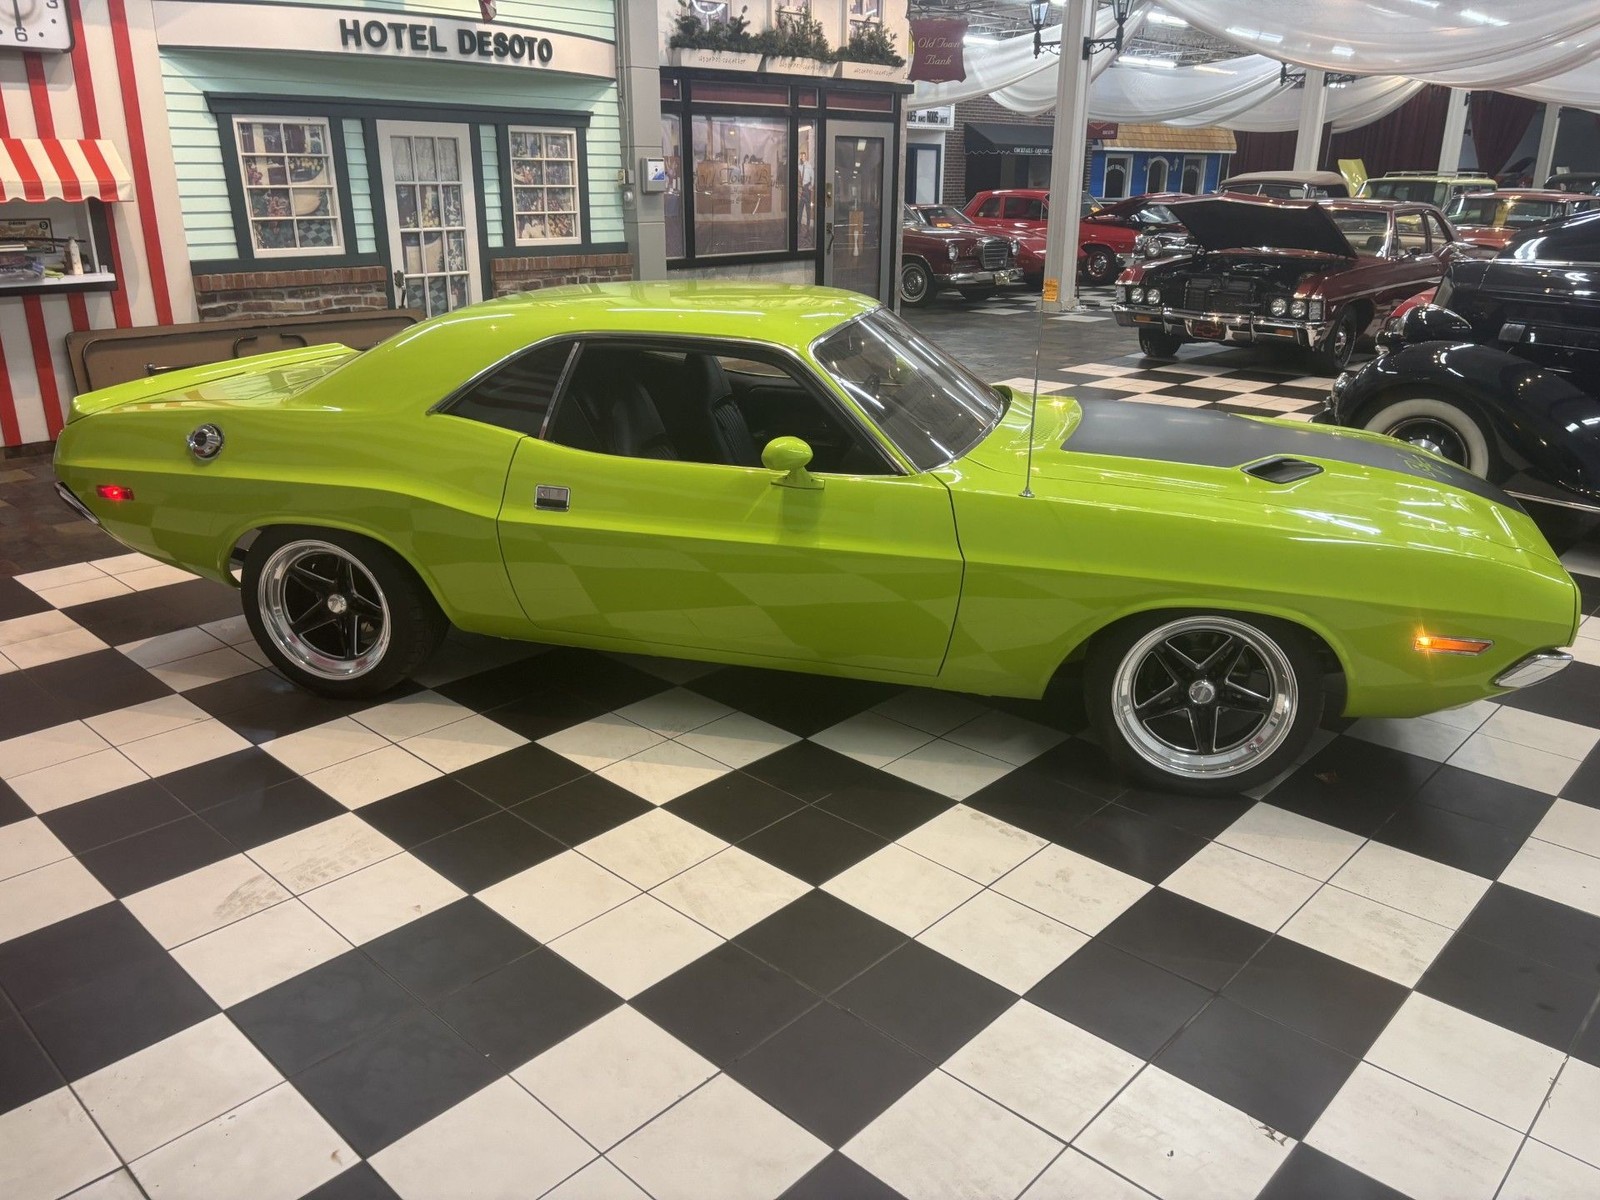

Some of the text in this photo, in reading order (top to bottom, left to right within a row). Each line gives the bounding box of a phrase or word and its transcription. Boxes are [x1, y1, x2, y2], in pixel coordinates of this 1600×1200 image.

[14, 27, 28, 42] 6
[339, 18, 553, 62] HOTEL DESOTO
[917, 36, 960, 48] Old Town
[924, 54, 953, 65] Bank
